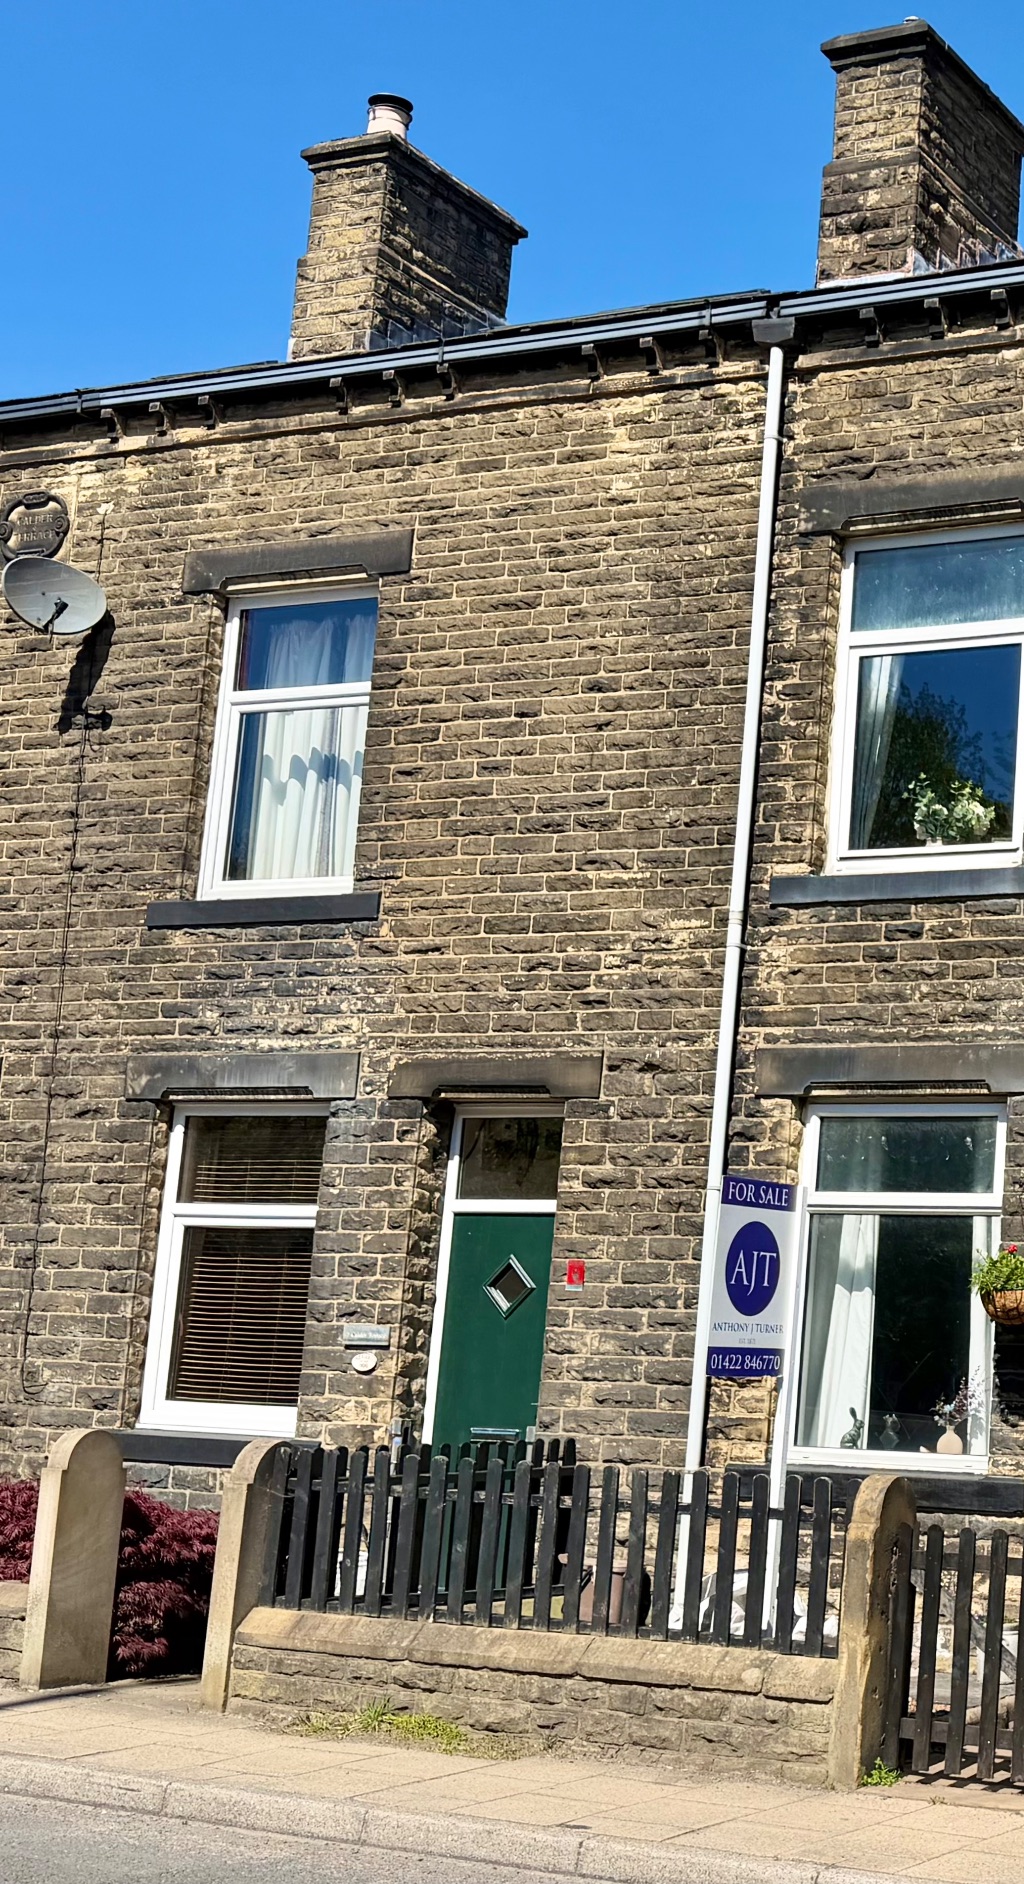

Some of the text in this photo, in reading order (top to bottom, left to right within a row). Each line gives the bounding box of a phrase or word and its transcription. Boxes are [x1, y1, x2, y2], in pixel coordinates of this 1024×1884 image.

[17, 514, 54, 526] CALDER
[13, 529, 55, 542] TERRACE
[728, 1181, 789, 1207] FOR SALE
[730, 1249, 777, 1296] AJT
[712, 1322, 751, 1333] ANTHONY
[755, 1323, 784, 1334] TURNER
[711, 1354, 781, 1370] 01422 846770
